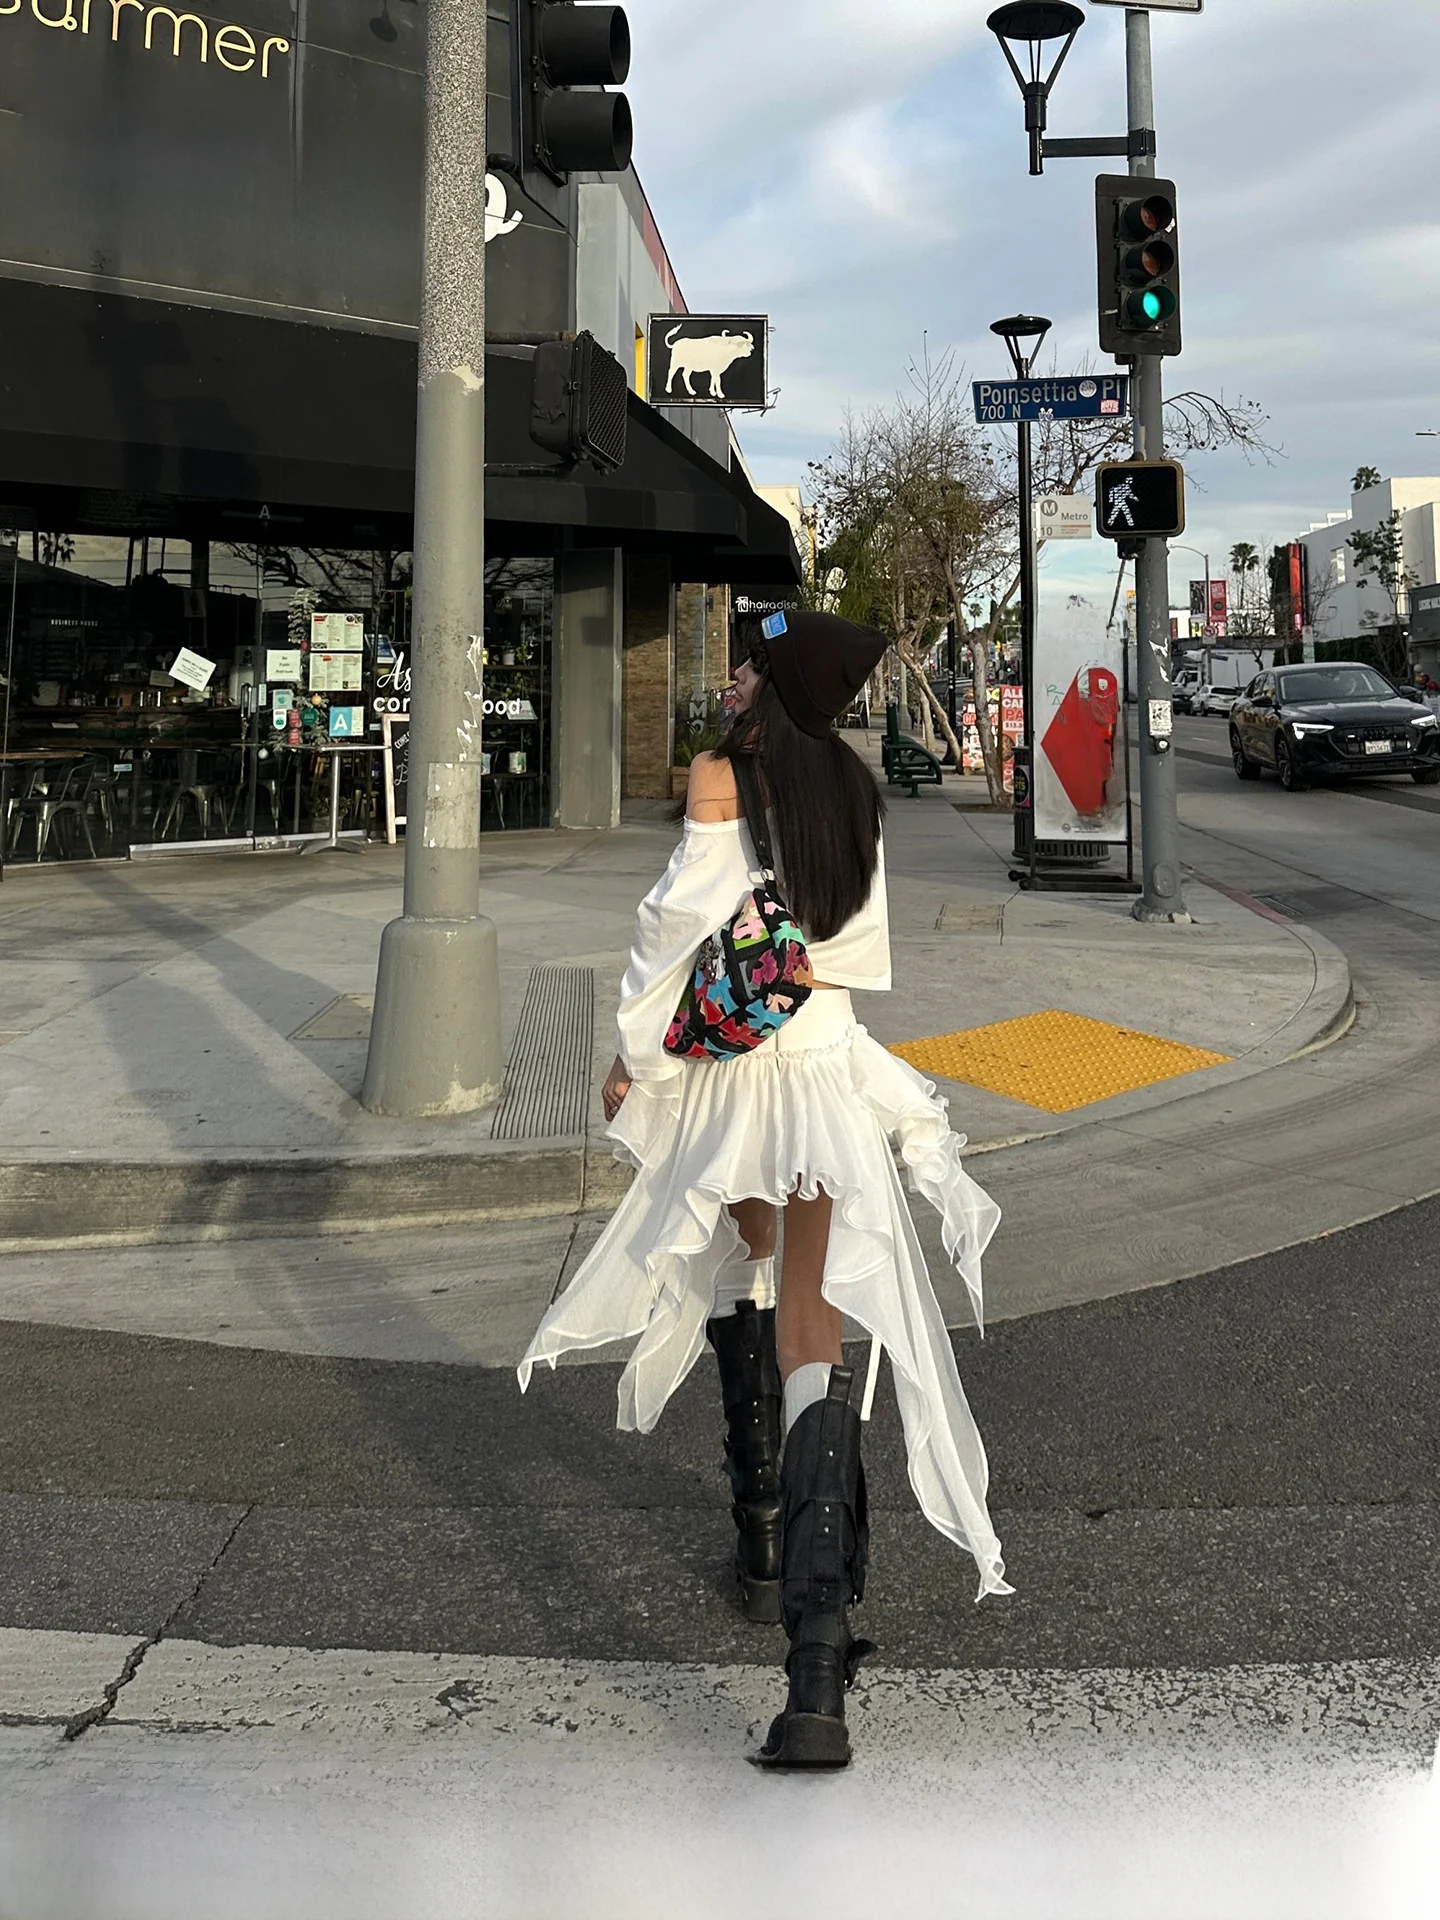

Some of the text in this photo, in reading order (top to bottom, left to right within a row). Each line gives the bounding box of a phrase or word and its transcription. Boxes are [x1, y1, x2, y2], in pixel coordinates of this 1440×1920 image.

[980, 379, 1120, 405] Poinsettia Pl
[980, 405, 1006, 420] 700
[1012, 404, 1021, 418] N
[1041, 527, 1052, 536] 10
[749, 600, 798, 609] hairadise
[333, 713, 348, 730] A
